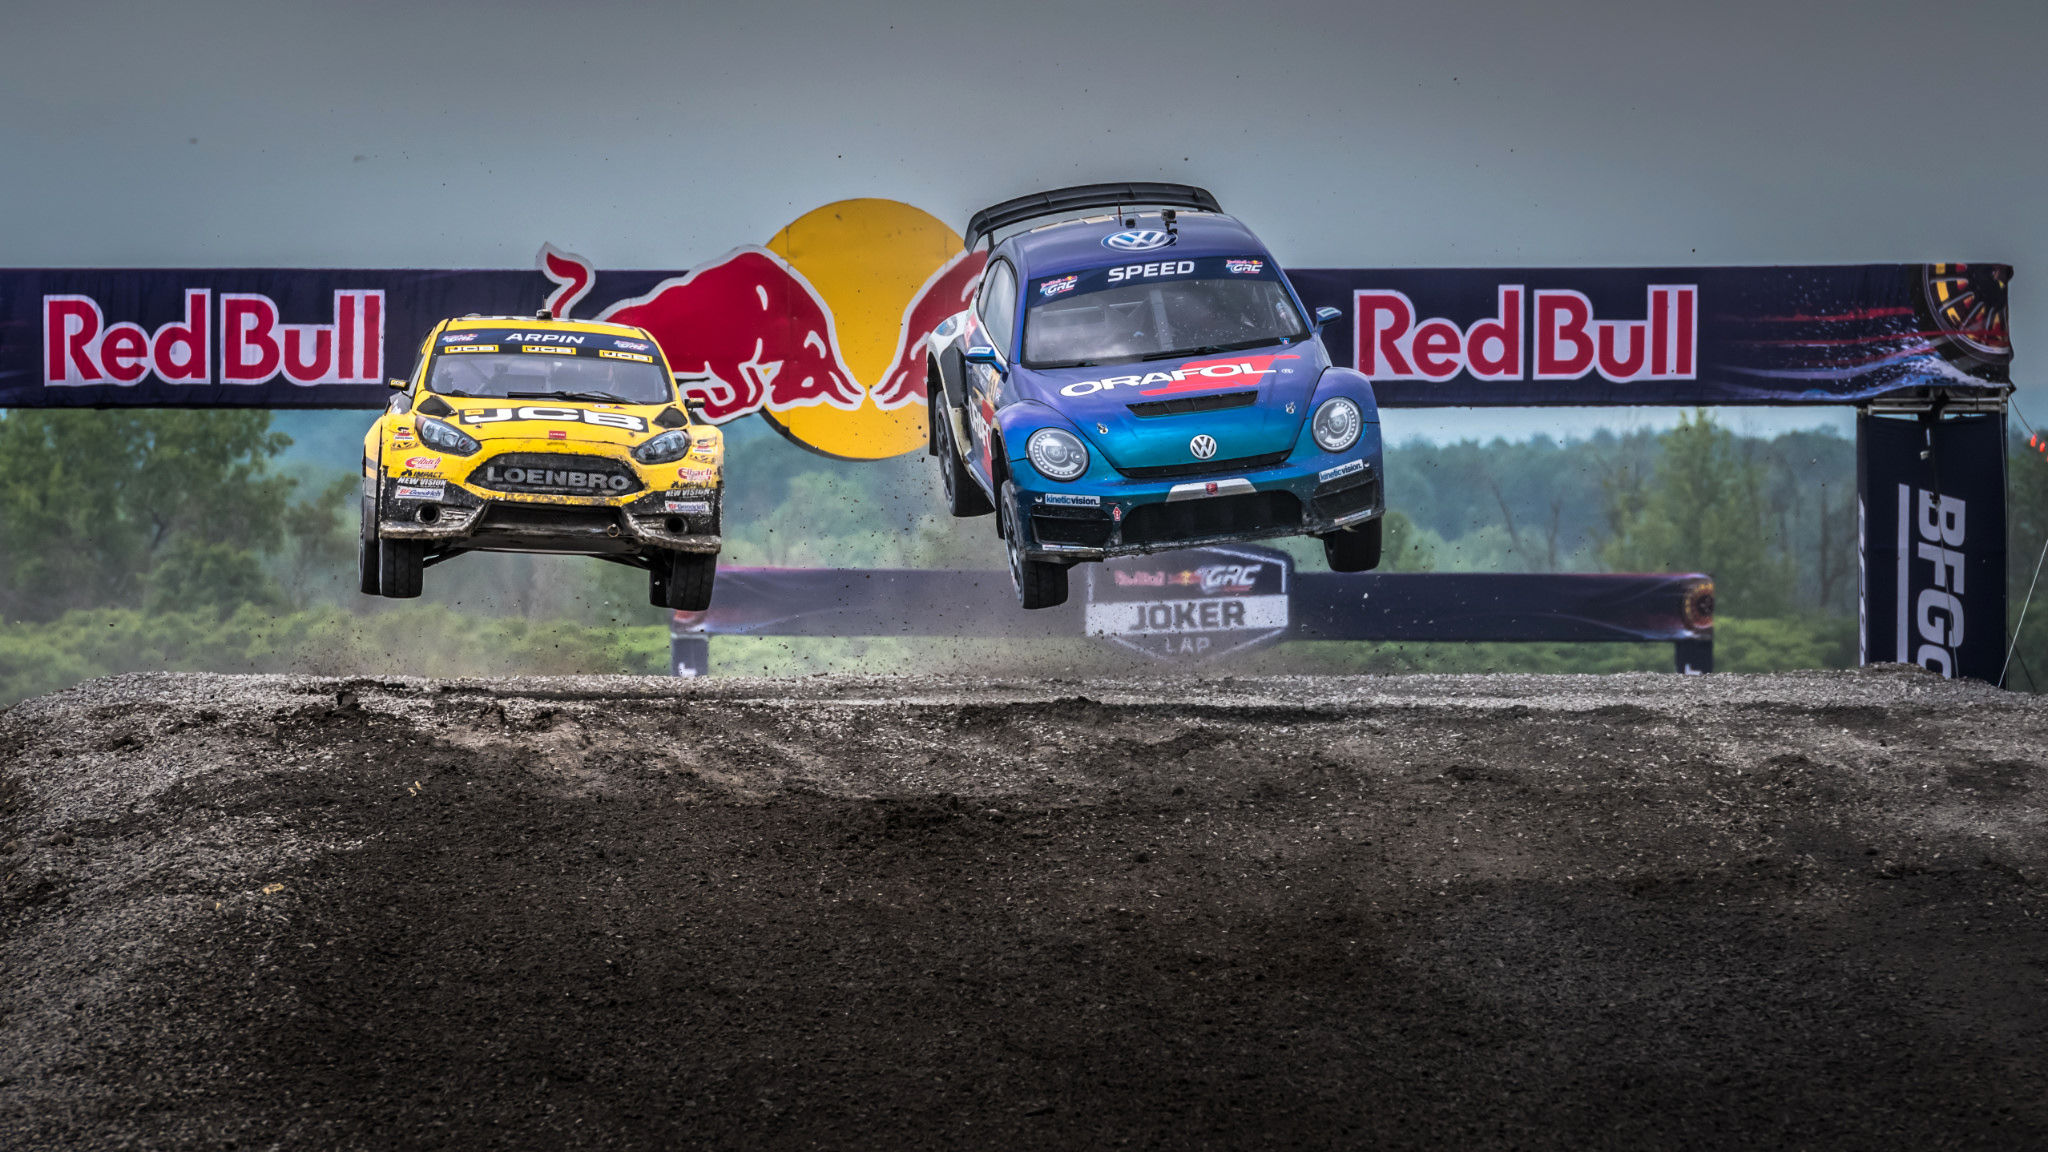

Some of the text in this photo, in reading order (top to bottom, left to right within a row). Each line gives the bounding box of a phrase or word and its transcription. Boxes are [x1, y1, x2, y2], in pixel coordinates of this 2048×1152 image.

[1107, 260, 1195, 282] SPEED
[46, 291, 383, 384] Red Bull
[504, 333, 585, 344] ARPIN
[1356, 286, 1695, 380] Red Bull
[1060, 362, 1277, 397] ORAFOL
[464, 406, 645, 431] JCB
[397, 477, 419, 485] NEW
[487, 466, 631, 491] LOENBRO
[1129, 600, 1245, 630] JOKER
[1165, 636, 1210, 653] LAP
